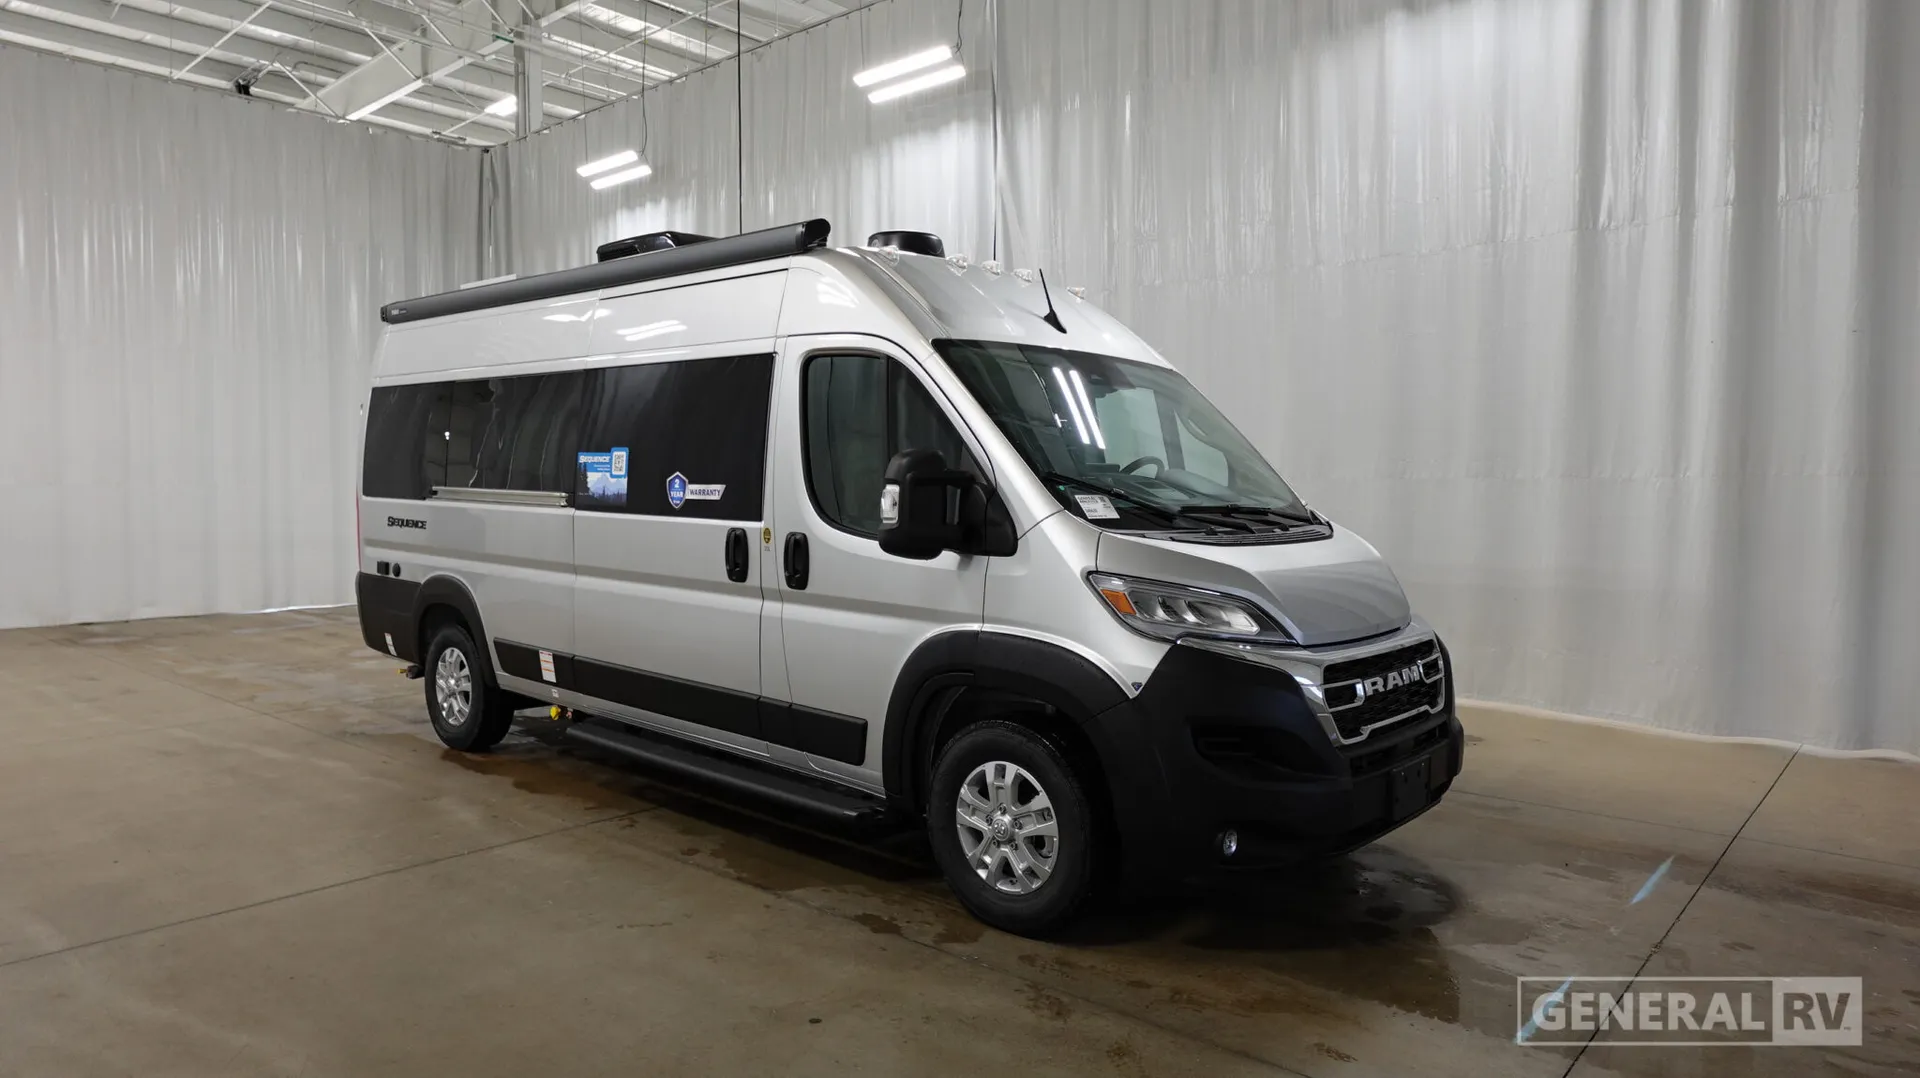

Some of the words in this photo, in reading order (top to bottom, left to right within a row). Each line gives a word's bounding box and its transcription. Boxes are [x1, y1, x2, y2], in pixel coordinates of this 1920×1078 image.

[674, 478, 680, 488] 2
[690, 488, 720, 497] WARRANTY
[387, 516, 427, 529] SEQUENCE
[1363, 665, 1420, 696] RAM
